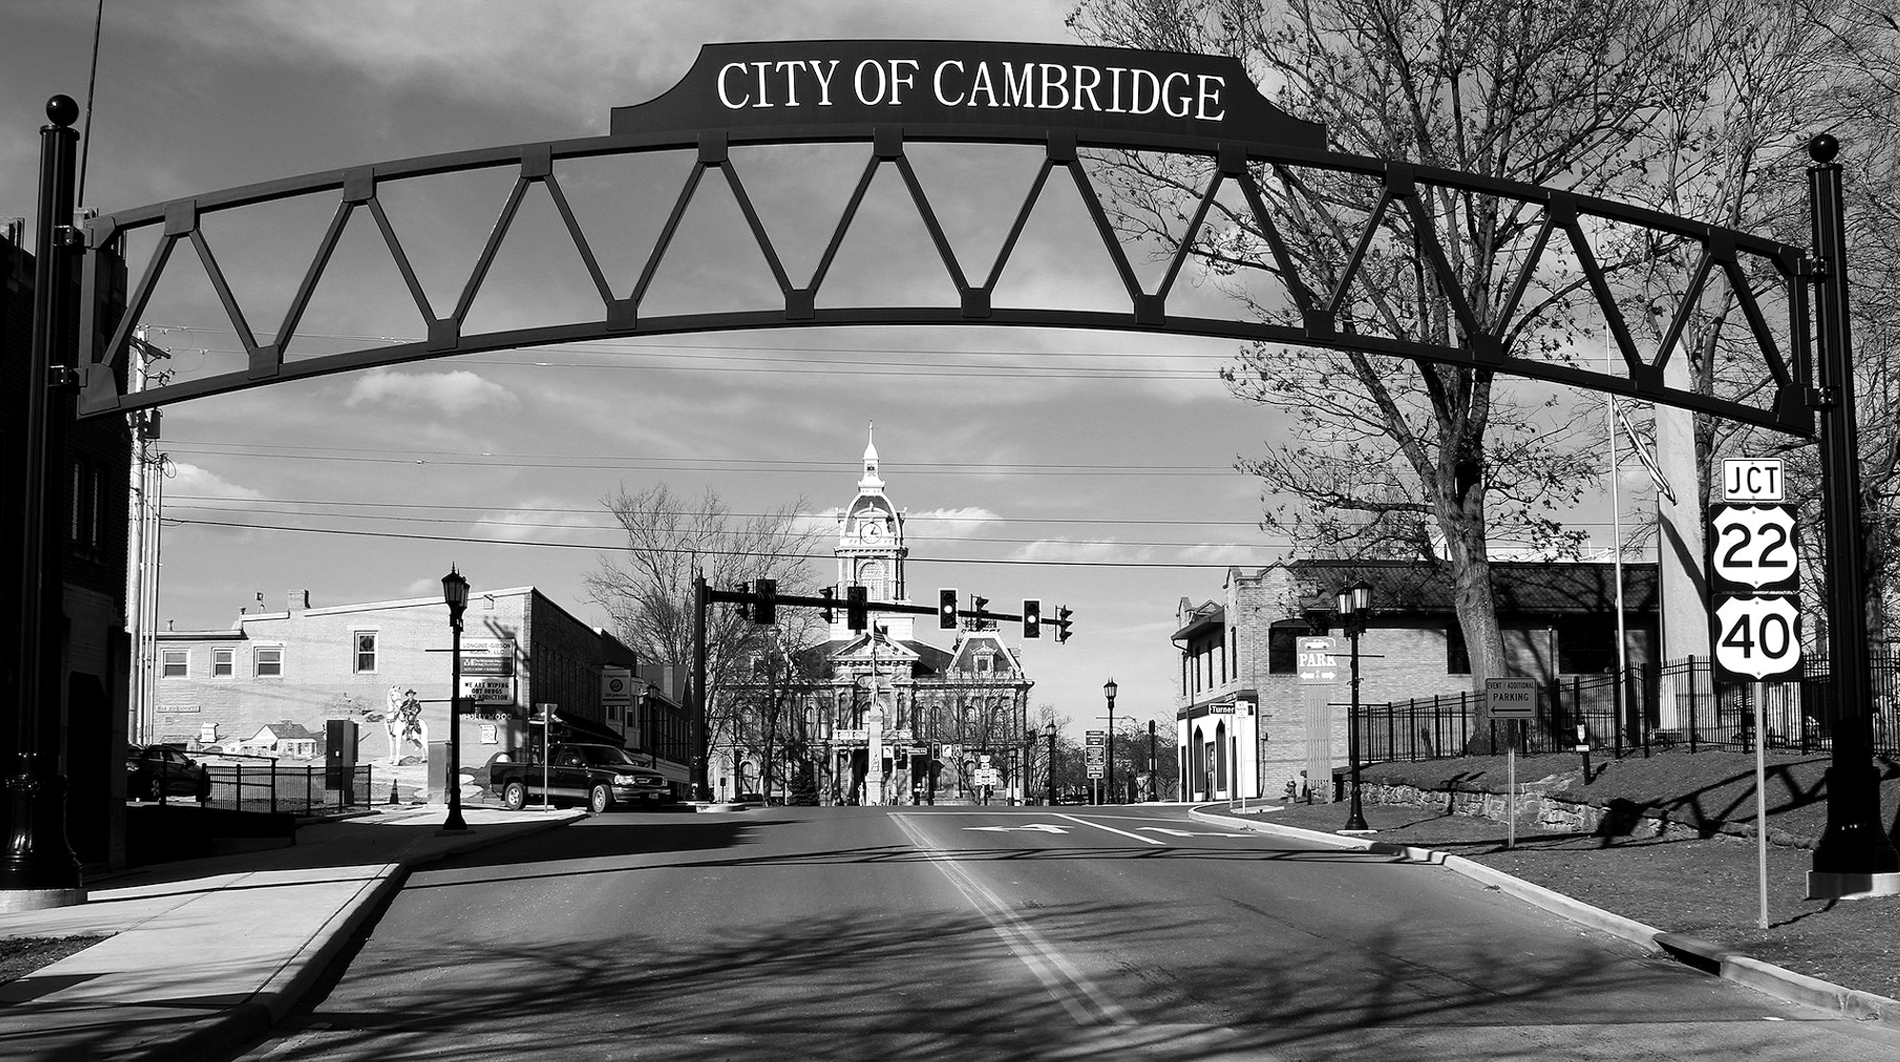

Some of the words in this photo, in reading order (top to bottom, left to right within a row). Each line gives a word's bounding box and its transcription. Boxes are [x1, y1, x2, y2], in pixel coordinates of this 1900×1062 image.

[716, 59, 841, 109] CITY
[853, 59, 920, 105] OF
[932, 59, 1228, 122] CAMBRIDGE
[1727, 466, 1779, 494] JCT
[1722, 522, 1788, 568] 22
[1722, 613, 1790, 659] 40
[1298, 653, 1338, 667] PARK
[1211, 705, 1235, 714] Turner
[1493, 693, 1529, 701] PARKING
